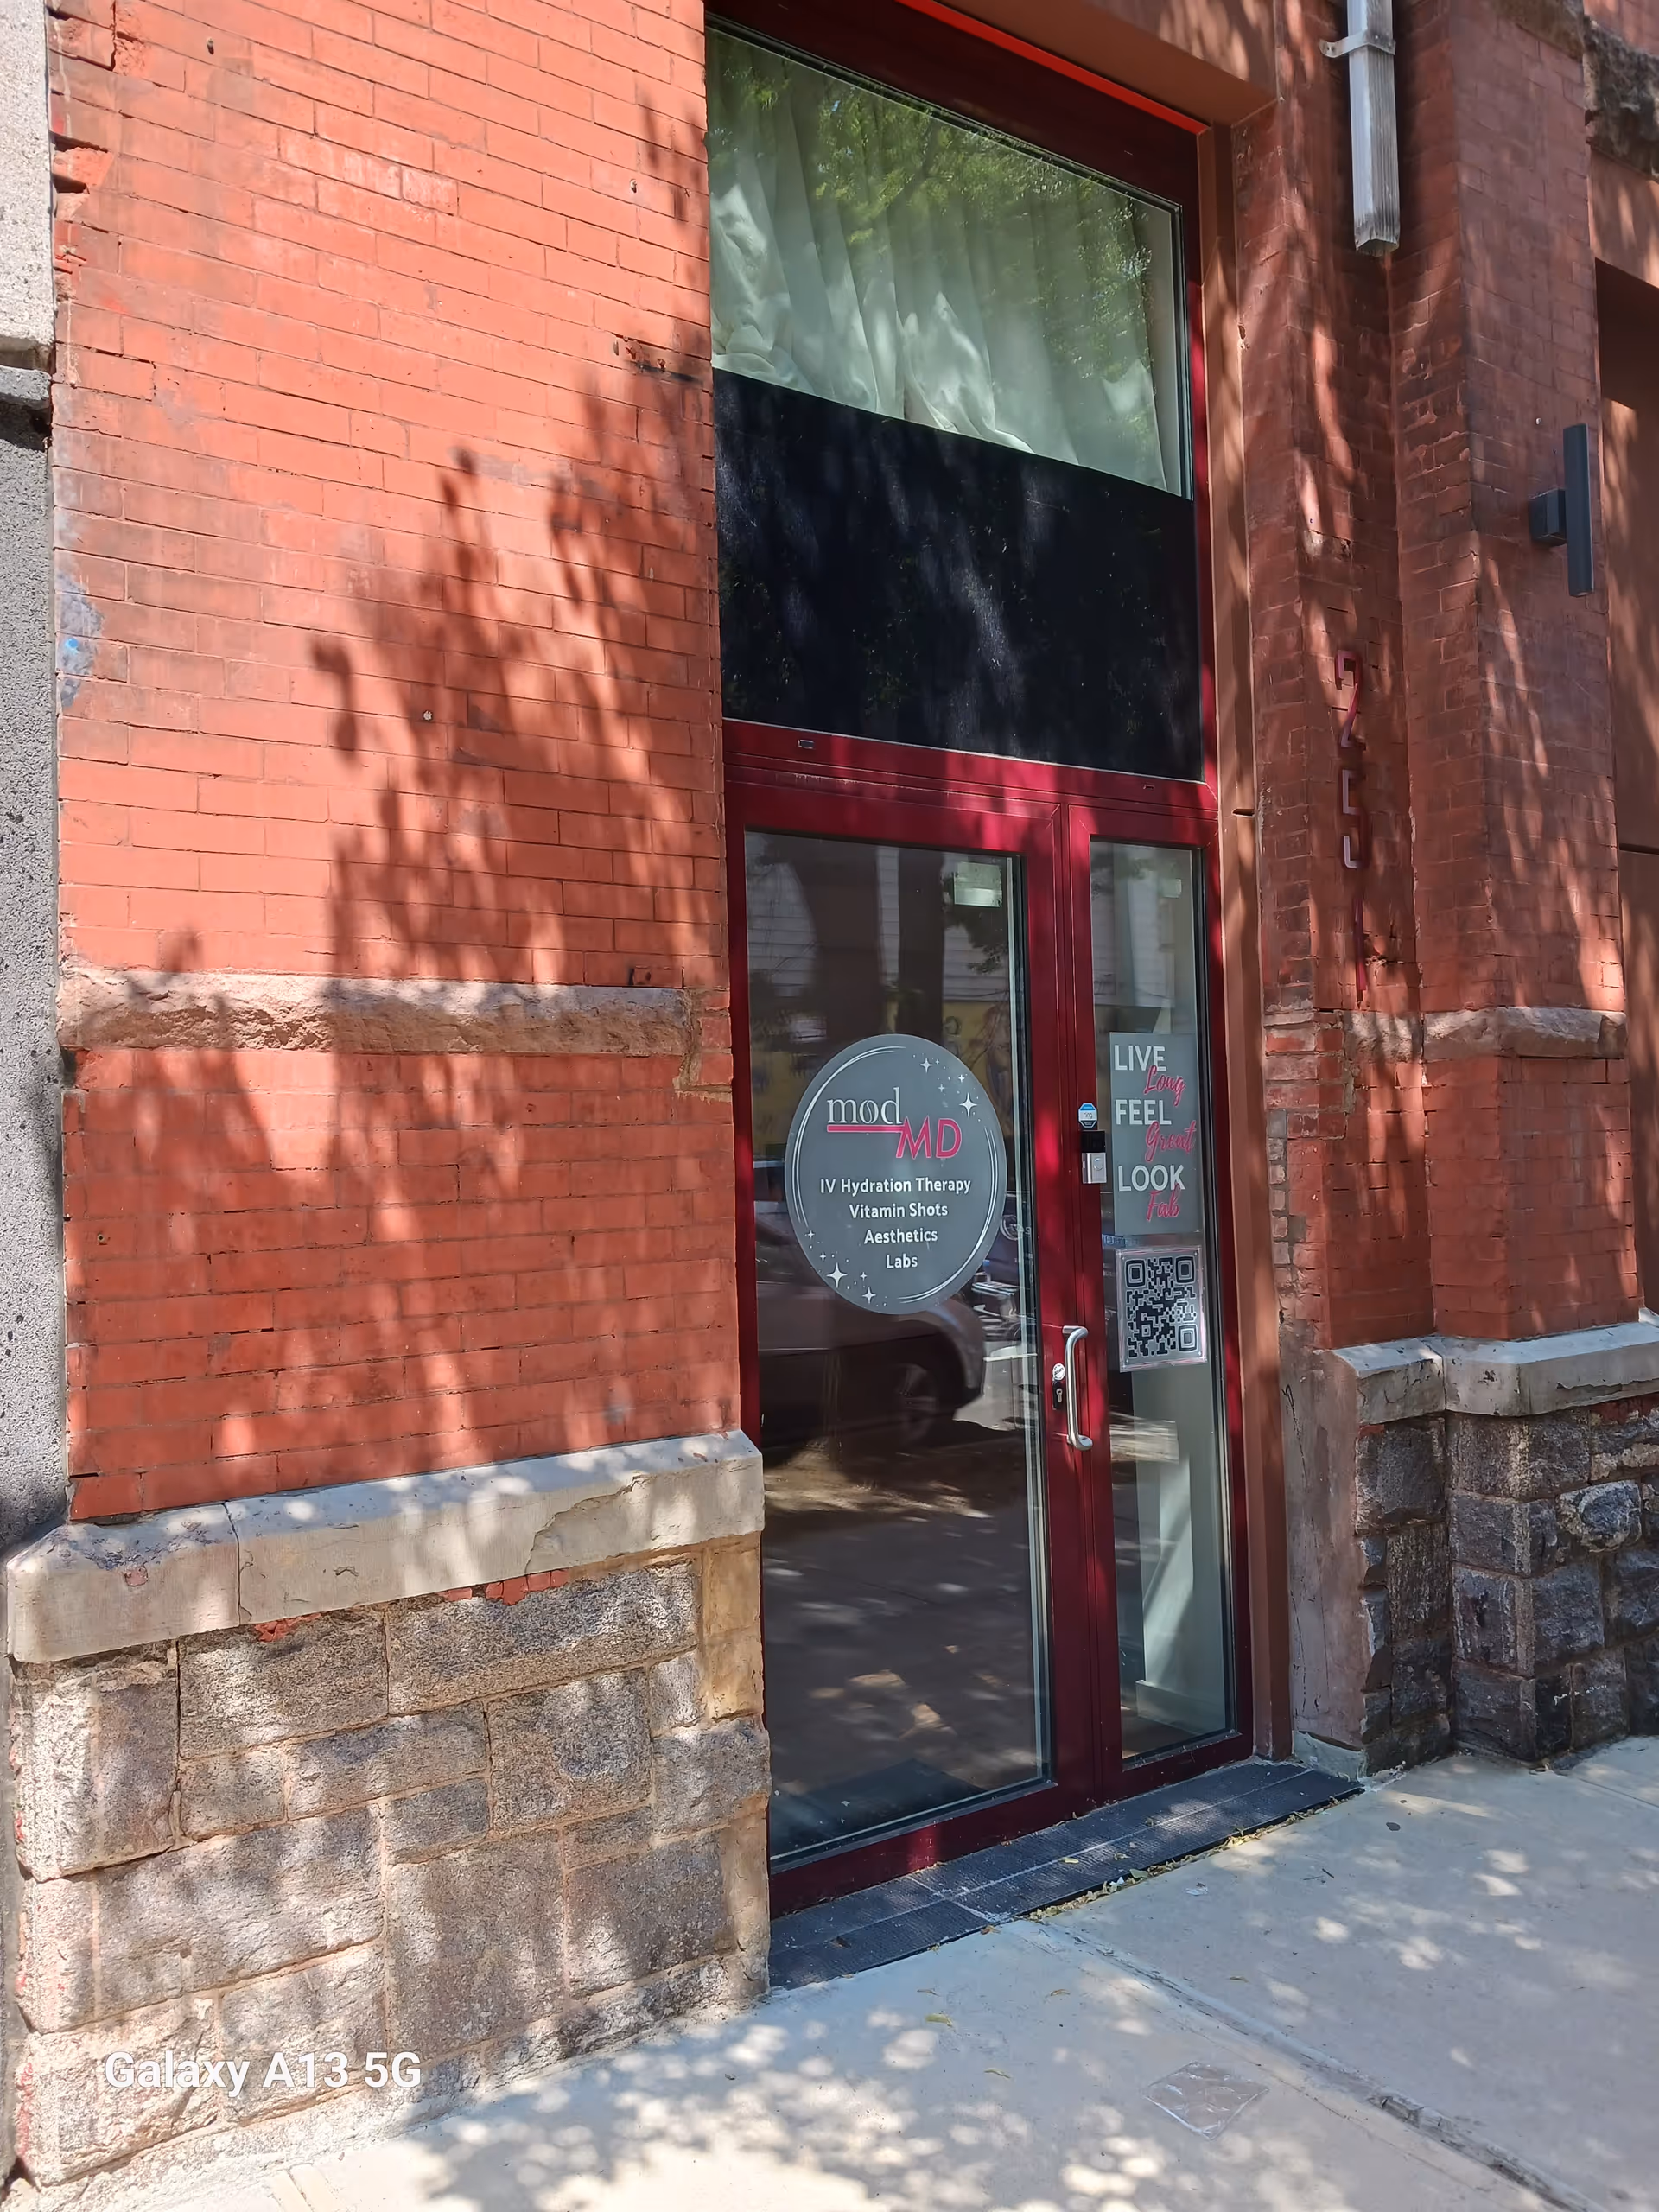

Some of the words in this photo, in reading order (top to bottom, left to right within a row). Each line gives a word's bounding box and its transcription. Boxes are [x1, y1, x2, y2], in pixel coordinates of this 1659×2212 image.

[1114, 1044, 1166, 1071] LIVE
[1143, 1065, 1186, 1107] Long
[826, 1086, 902, 1124] mod
[895, 1115, 963, 1160] MD
[1116, 1099, 1172, 1125] FEEL
[1145, 1120, 1197, 1162] Great
[820, 1179, 836, 1193] IV
[841, 1177, 912, 1197] Hydration
[915, 1177, 971, 1194] Therapy
[1117, 1165, 1185, 1192] LOOK
[849, 1203, 905, 1219] Vitamin
[908, 1202, 948, 1217] Shots
[1146, 1182, 1181, 1222] Fab
[864, 1228, 938, 1244] Aesthetics
[886, 1254, 918, 1269] Labs
